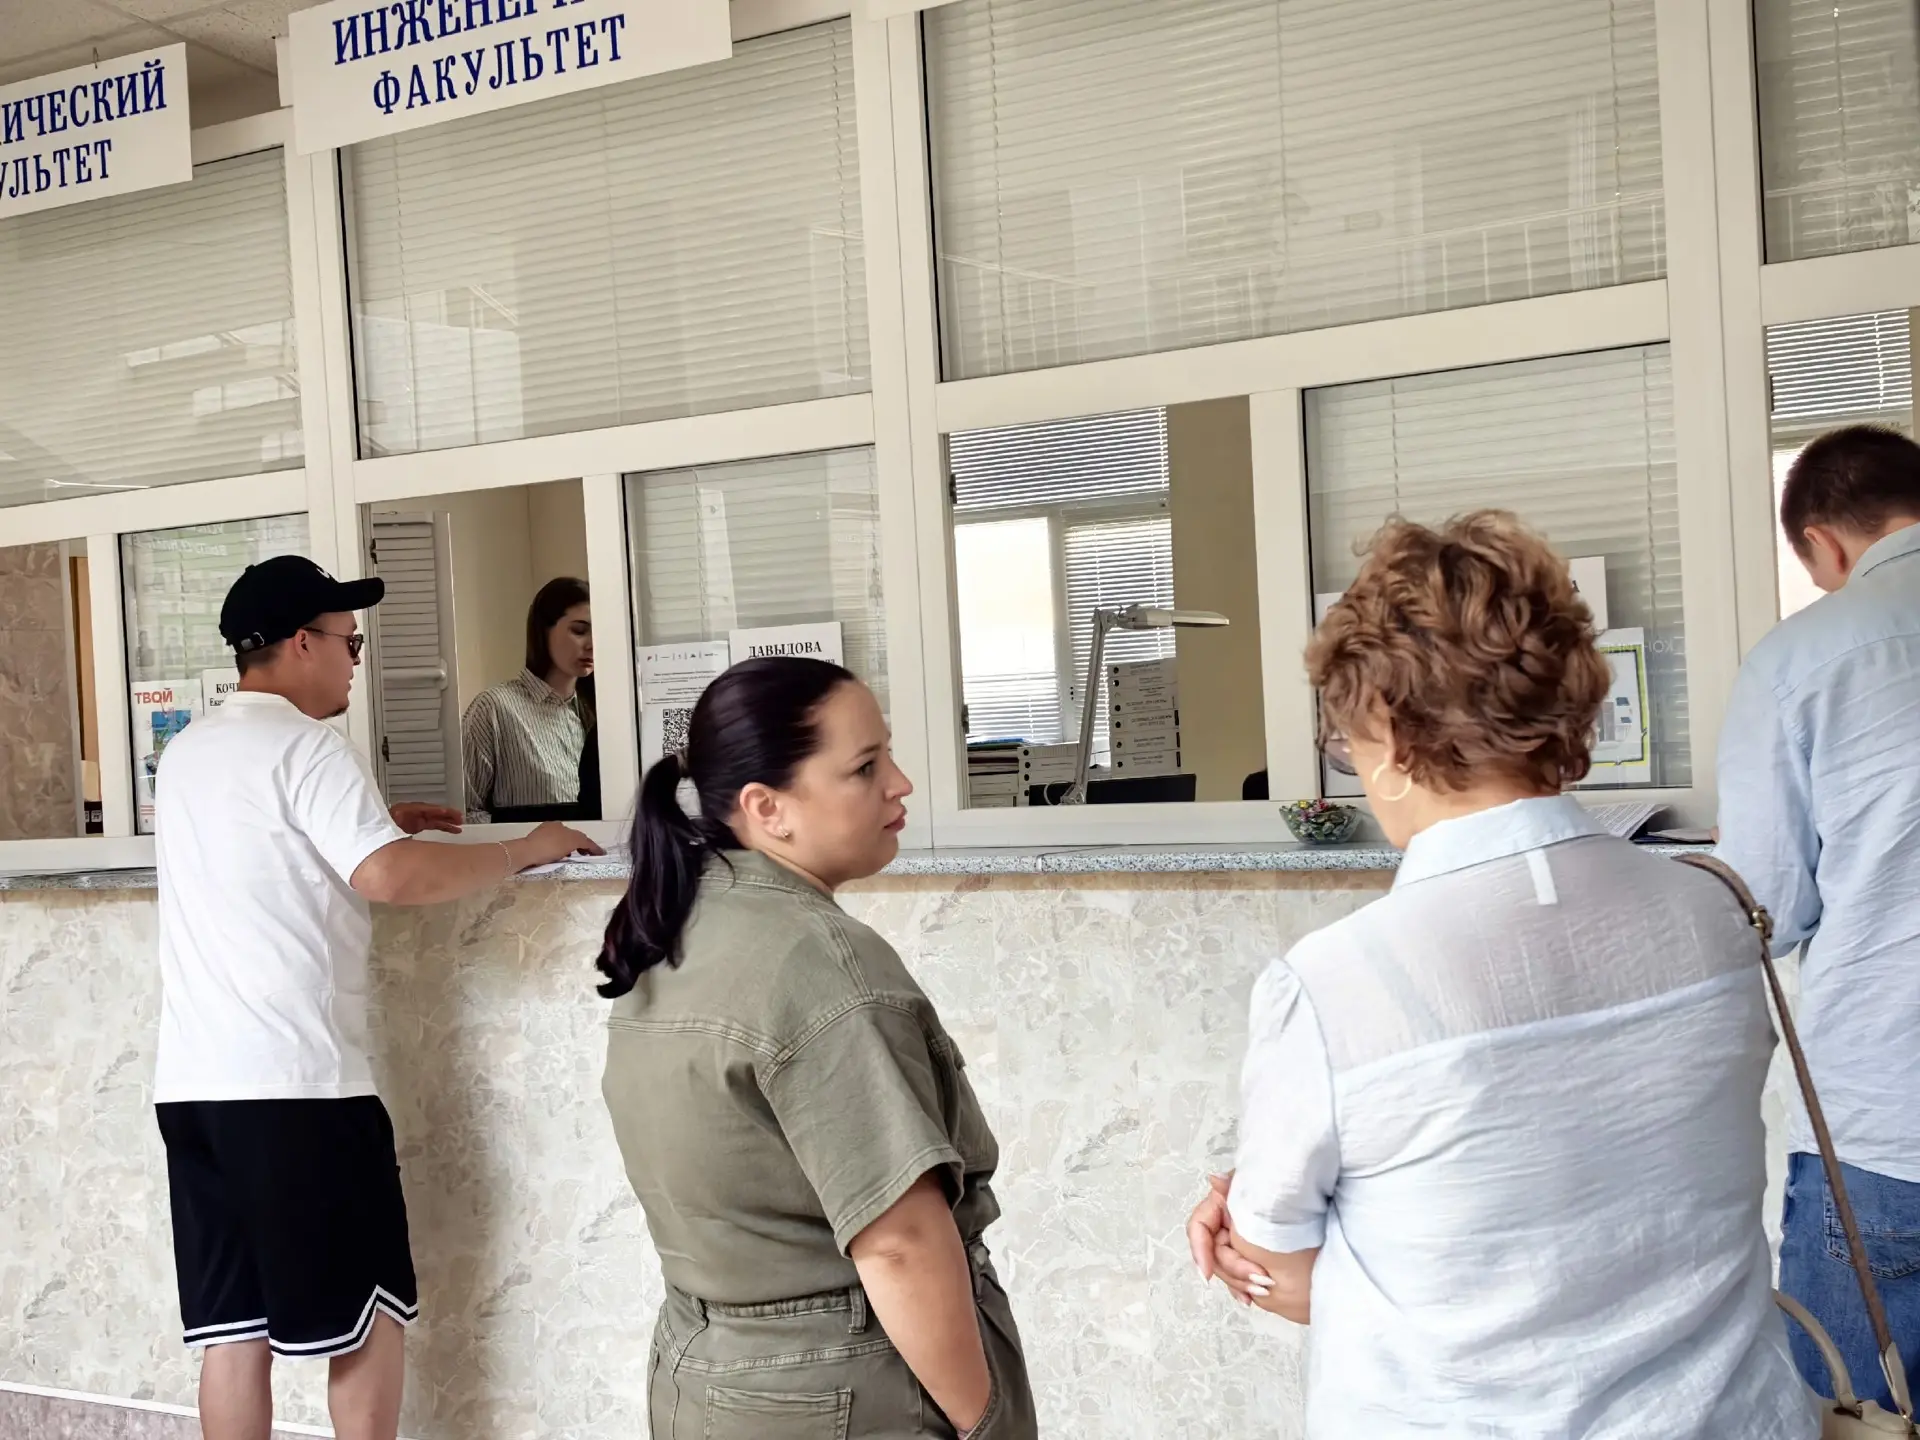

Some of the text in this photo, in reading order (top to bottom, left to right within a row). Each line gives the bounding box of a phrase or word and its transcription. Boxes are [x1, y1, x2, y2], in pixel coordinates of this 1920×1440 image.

[373, 13, 625, 115] ФАКУЛЬТЕТ
[0, 58, 167, 145] ИЧЕСКИЙ
[748, 641, 823, 659] ДАВЫДОВА
[134, 688, 173, 705] ТВОЙ
